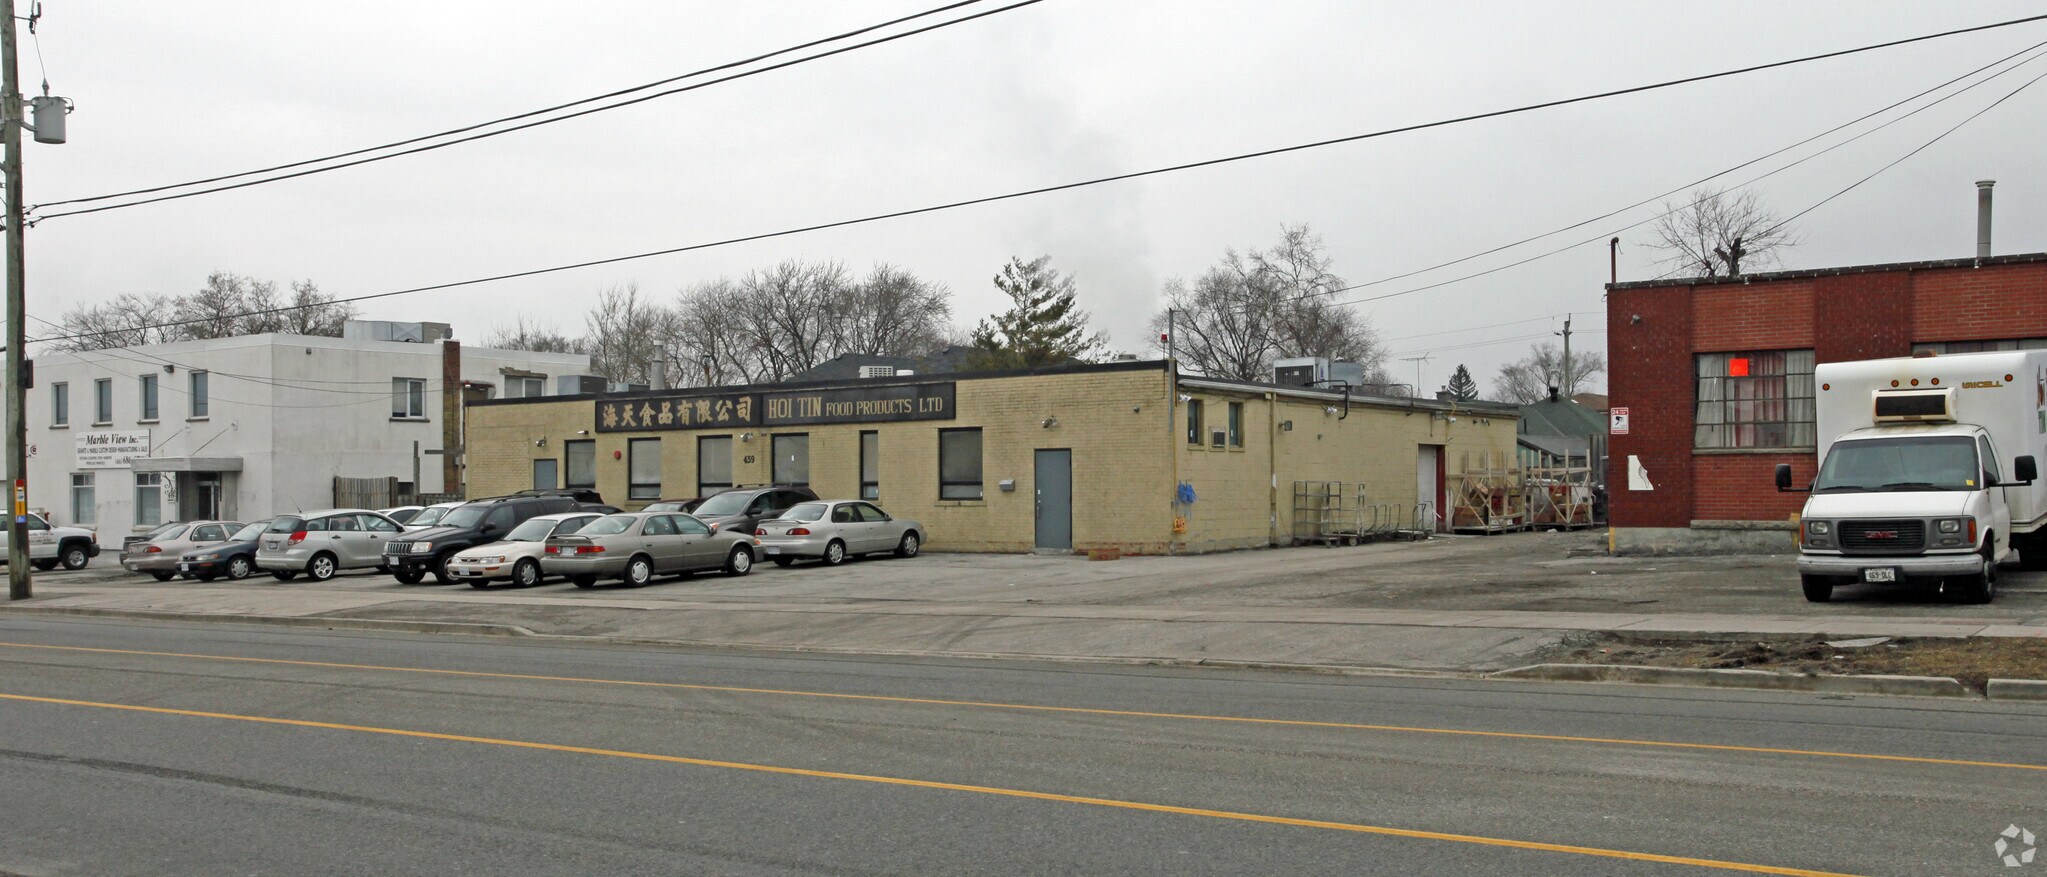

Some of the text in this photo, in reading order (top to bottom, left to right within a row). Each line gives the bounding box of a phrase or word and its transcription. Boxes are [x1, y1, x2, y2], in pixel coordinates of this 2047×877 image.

[602, 396, 752, 428] 海天食品有限公司
[768, 396, 943, 419] HOI TIN FOOD PRODUCTS LTD
[86, 434, 109, 445] Marble
[111, 433, 128, 444] View
